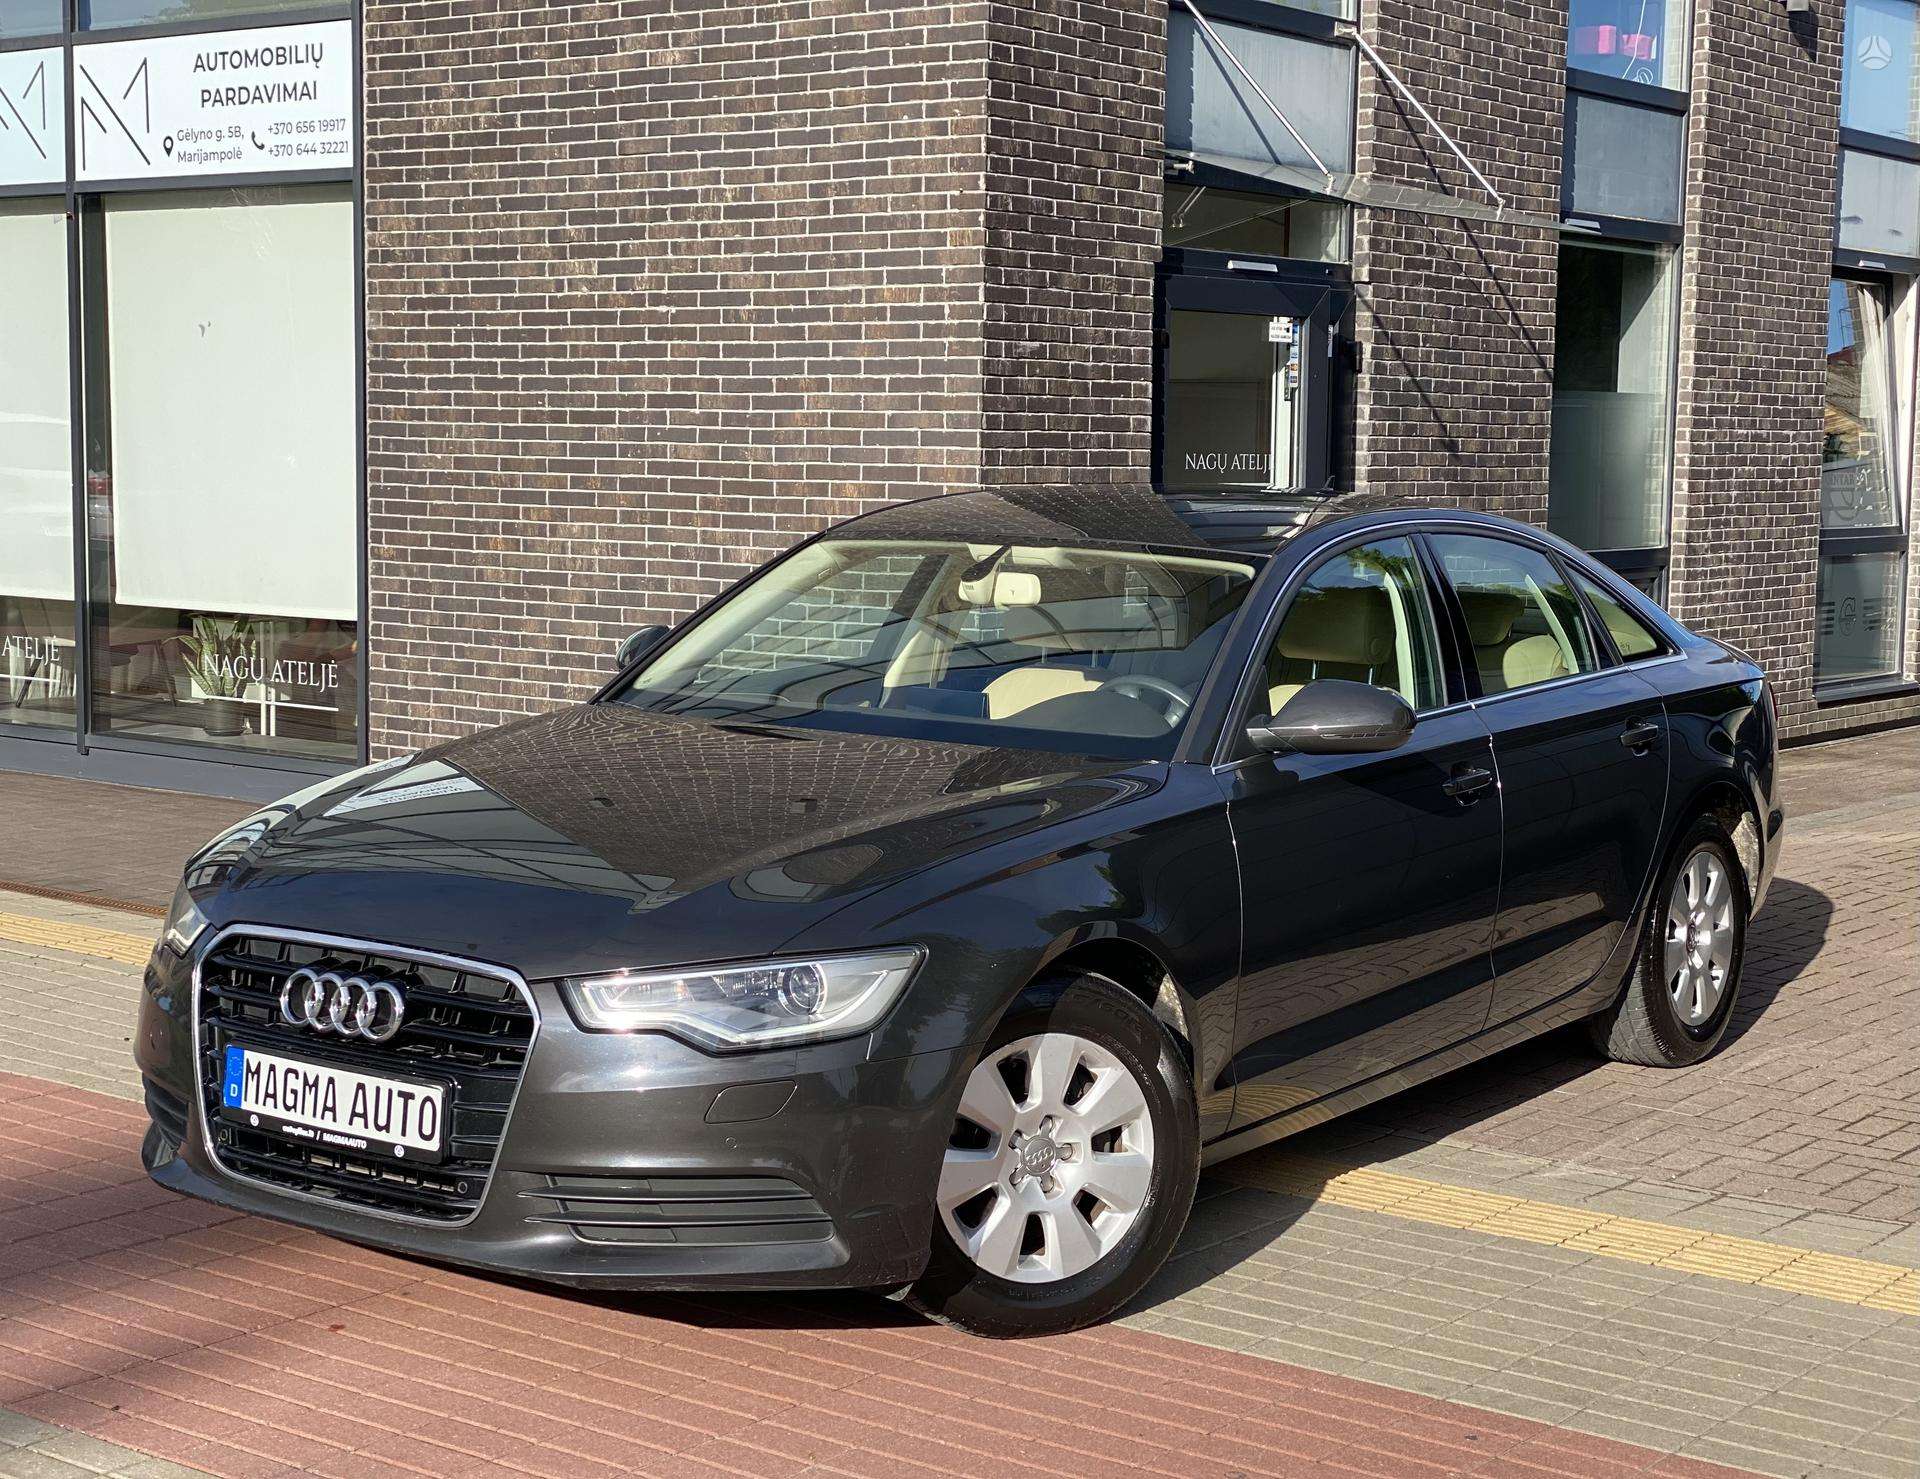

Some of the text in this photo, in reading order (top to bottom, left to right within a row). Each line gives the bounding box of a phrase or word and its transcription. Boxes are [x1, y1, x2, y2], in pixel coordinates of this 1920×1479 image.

[193, 43, 324, 73] AUTOMOBILIŲ
[200, 80, 318, 108] PARDAVIMAI
[176, 125, 245, 144] Gėlyno g. 5B,
[268, 118, 346, 135] +370 656 19917
[177, 147, 243, 165] Marijampolė
[268, 140, 349, 158] +370 644 32221
[1184, 453, 1228, 474] NAGŲ
[1, 635, 60, 666] ATELJĖ
[202, 653, 339, 693] NAGŲ ATELJĖ
[229, 1083, 238, 1097] D
[243, 1057, 438, 1142] MAGMA AUTO
